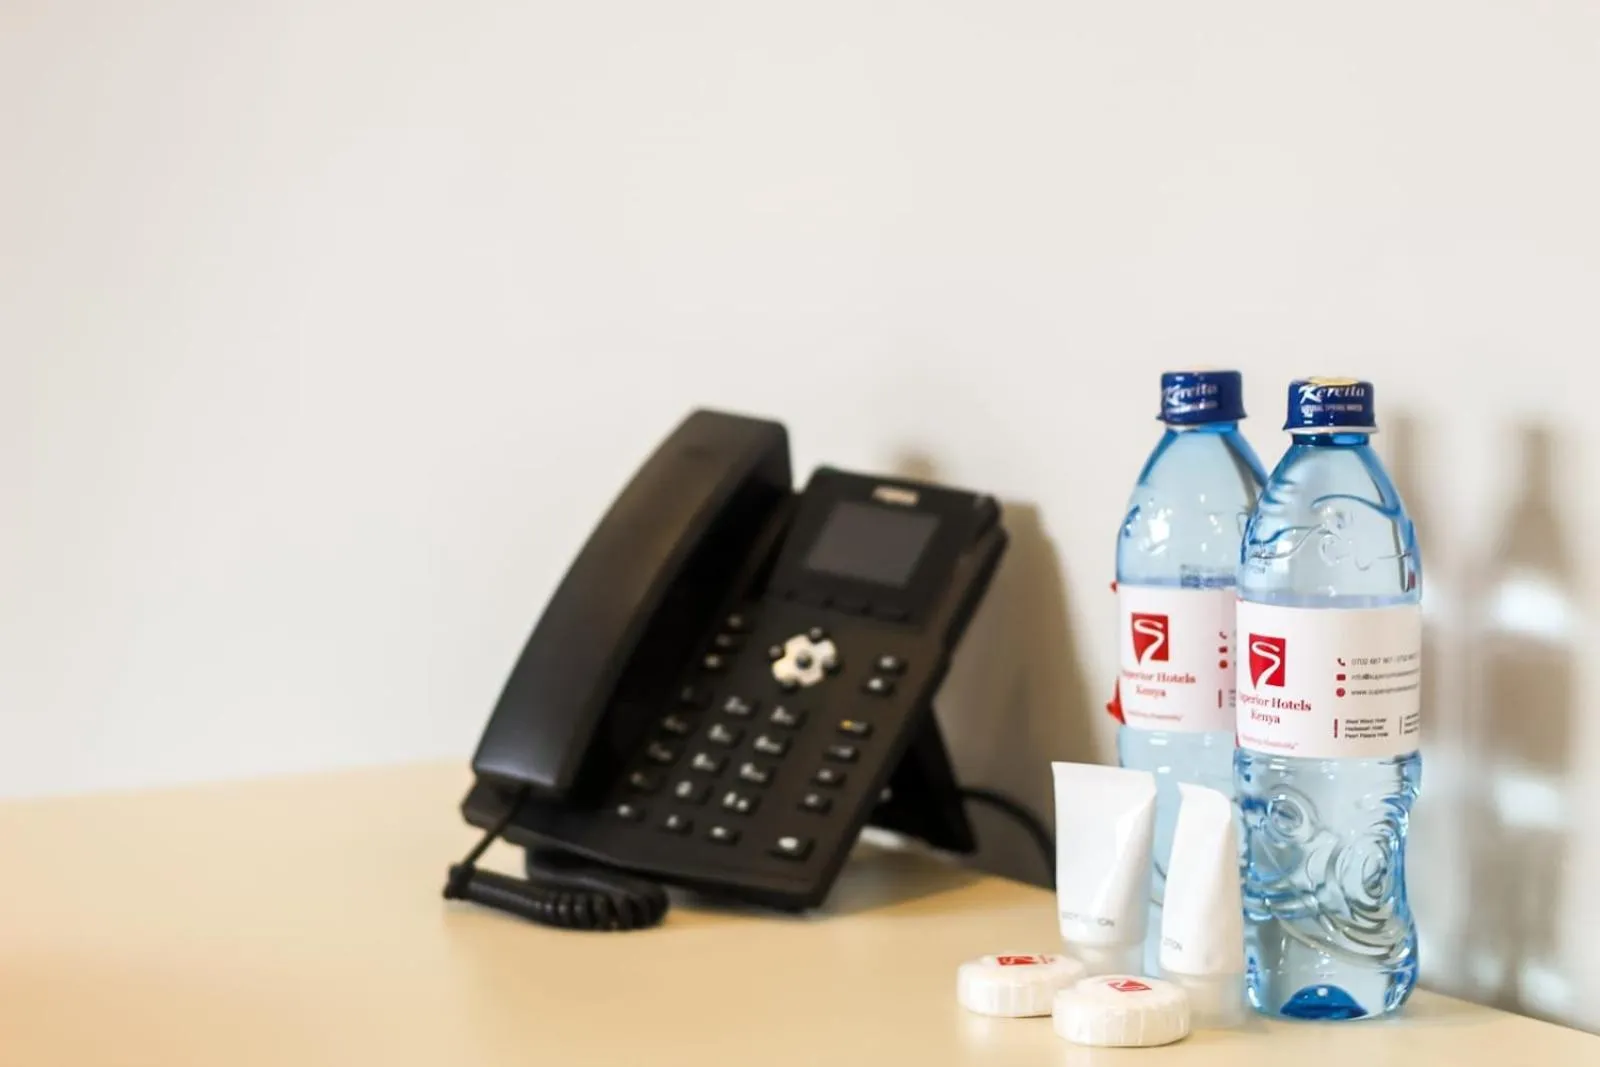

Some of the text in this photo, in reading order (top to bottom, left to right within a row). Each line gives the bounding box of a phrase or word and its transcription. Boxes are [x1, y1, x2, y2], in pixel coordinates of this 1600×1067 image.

[1238, 692, 1270, 708] uperior
[1271, 697, 1312, 712] Hotels
[1250, 710, 1281, 725] Kenya
